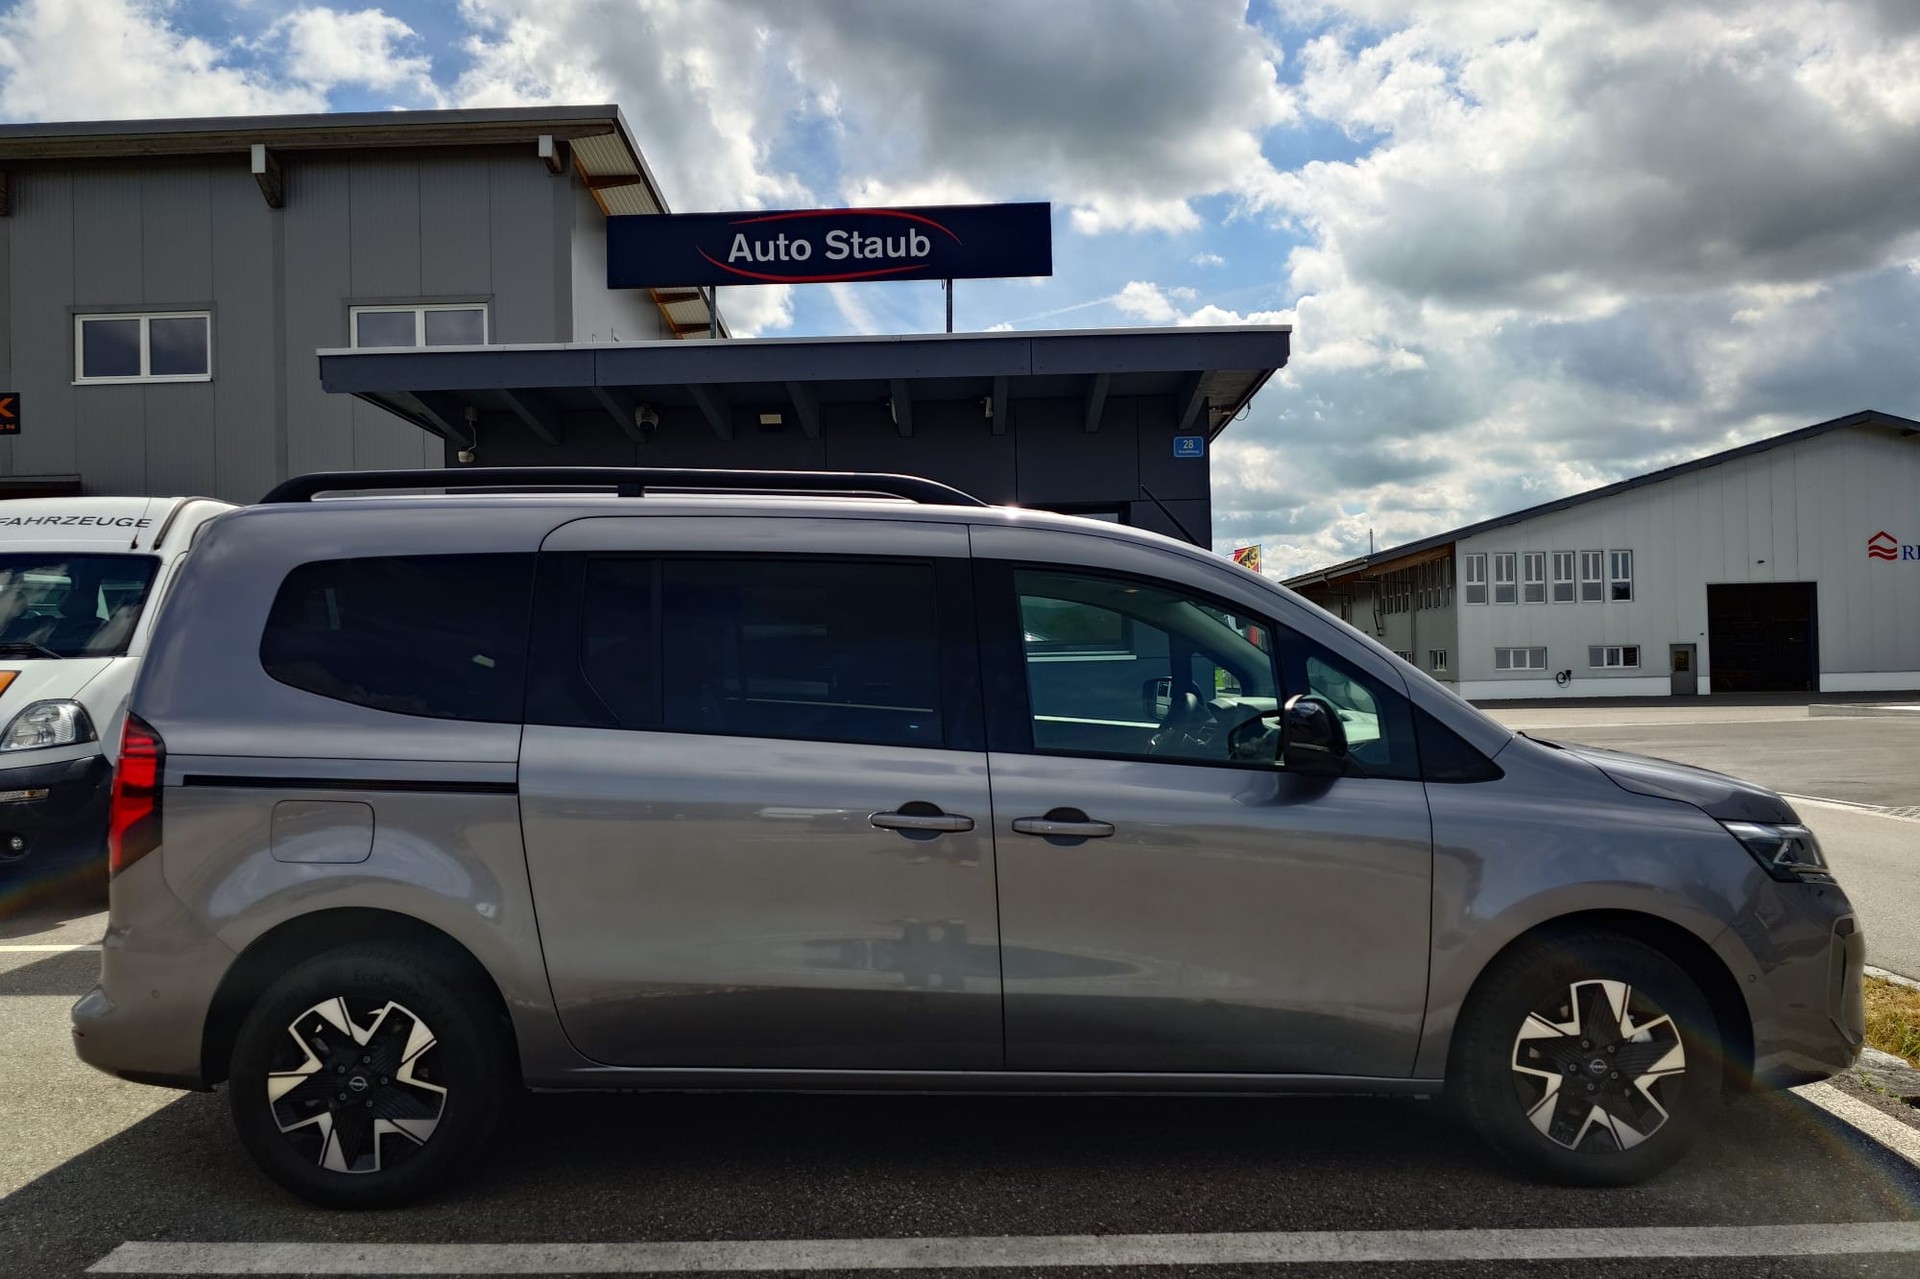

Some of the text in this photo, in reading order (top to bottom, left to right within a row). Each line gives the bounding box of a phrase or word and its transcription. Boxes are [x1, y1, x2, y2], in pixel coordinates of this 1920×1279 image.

[728, 228, 931, 263] Auto Staub
[1183, 439, 1194, 449] 28
